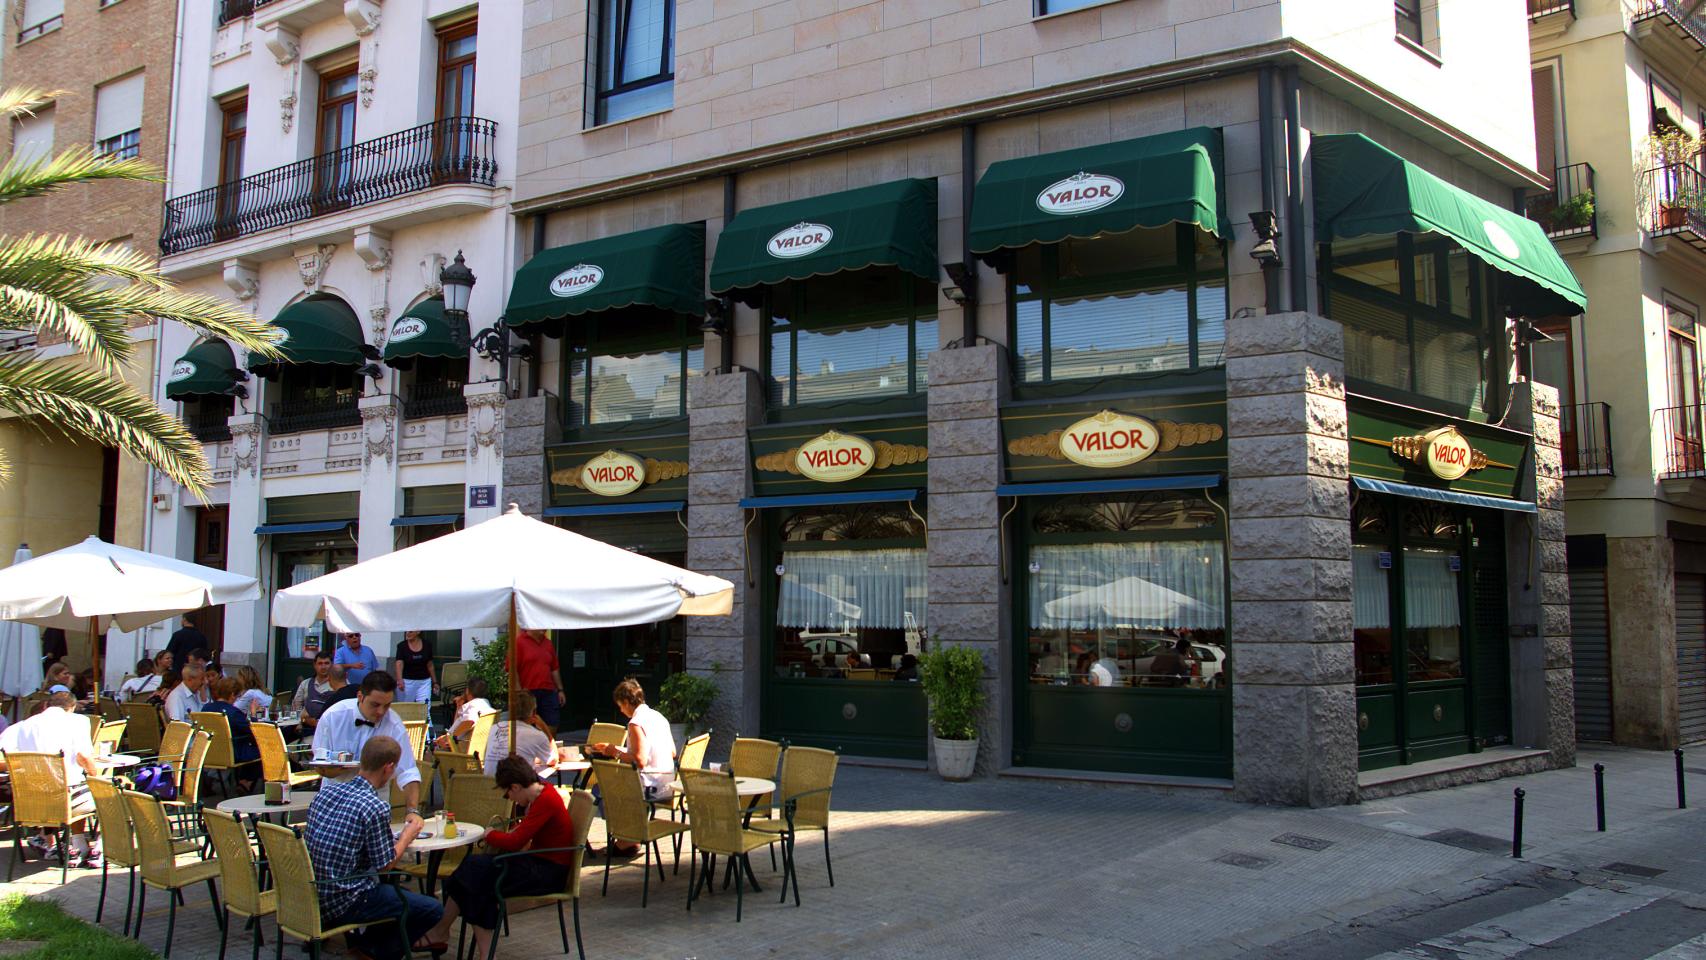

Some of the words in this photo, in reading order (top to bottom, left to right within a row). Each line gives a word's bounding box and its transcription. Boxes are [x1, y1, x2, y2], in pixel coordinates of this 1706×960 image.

[1046, 184, 1115, 206] VALOR
[775, 232, 825, 250] VALOR
[557, 273, 597, 289] VALOR
[1068, 429, 1149, 452] VALOR
[803, 447, 867, 469] VALOR
[1433, 442, 1466, 468] VALOR
[587, 465, 640, 483] VALOR
